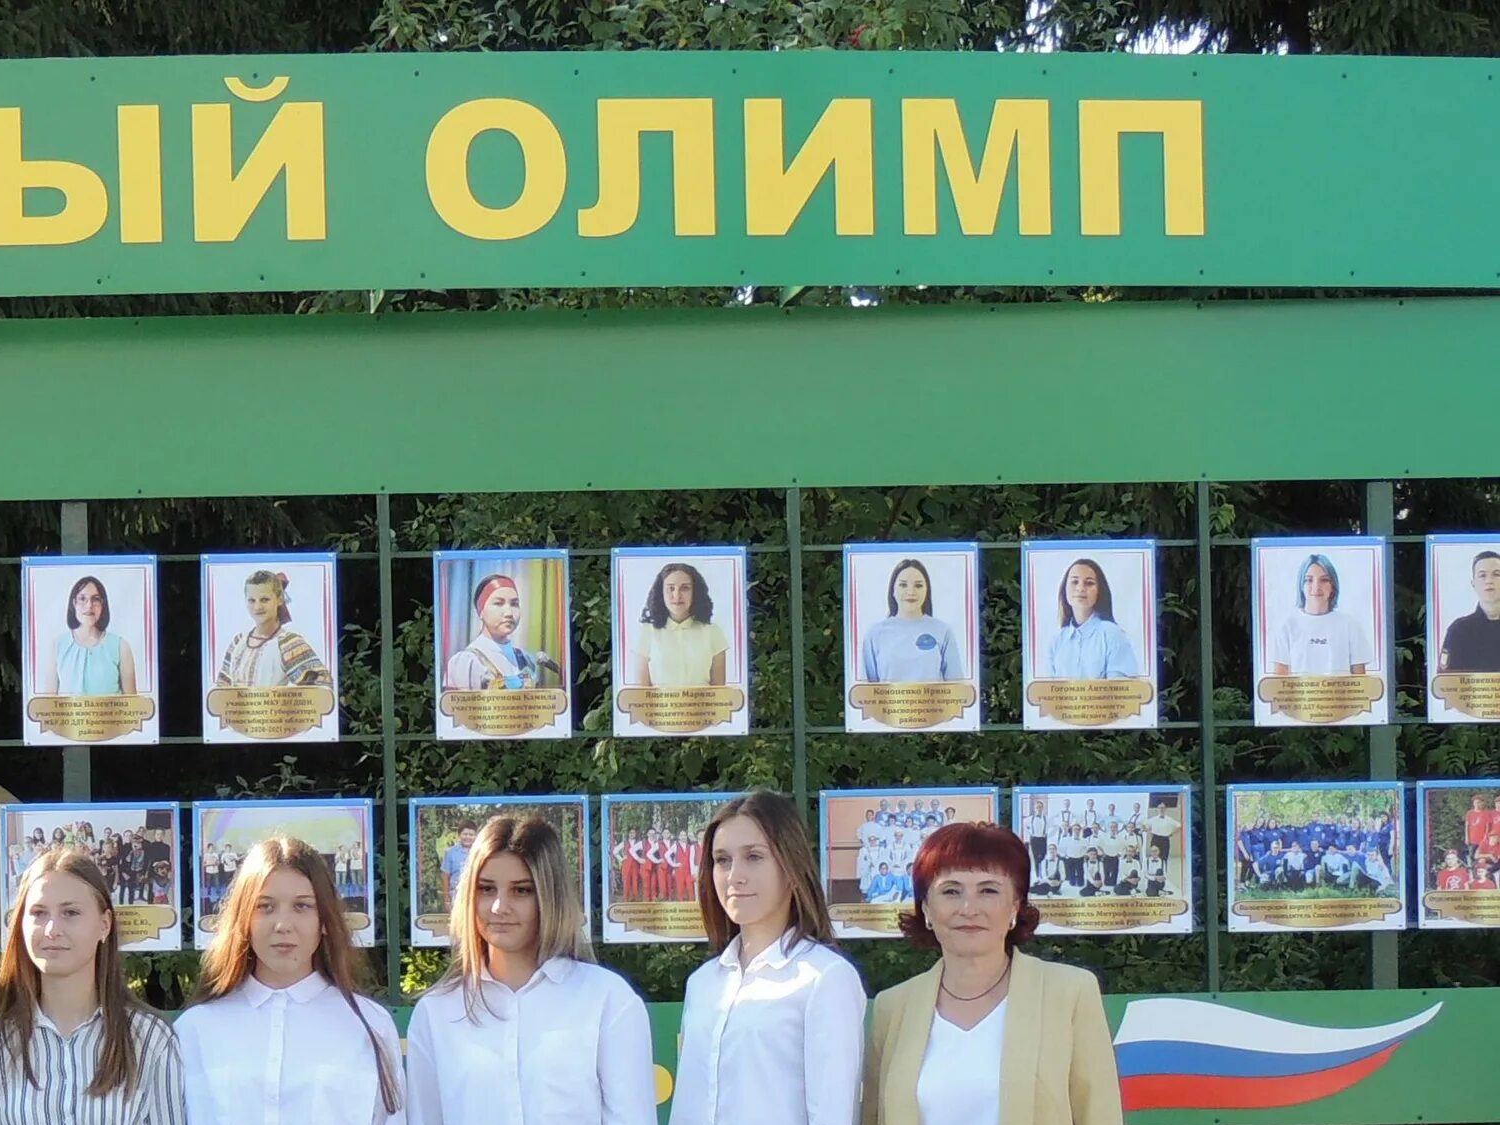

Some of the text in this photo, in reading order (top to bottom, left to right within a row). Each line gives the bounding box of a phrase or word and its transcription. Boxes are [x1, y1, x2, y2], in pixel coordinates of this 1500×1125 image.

[424, 97, 1205, 241] ОЛИМП
[1282, 680, 1319, 688] Тарасова
[923, 687, 951, 695] Ирина
